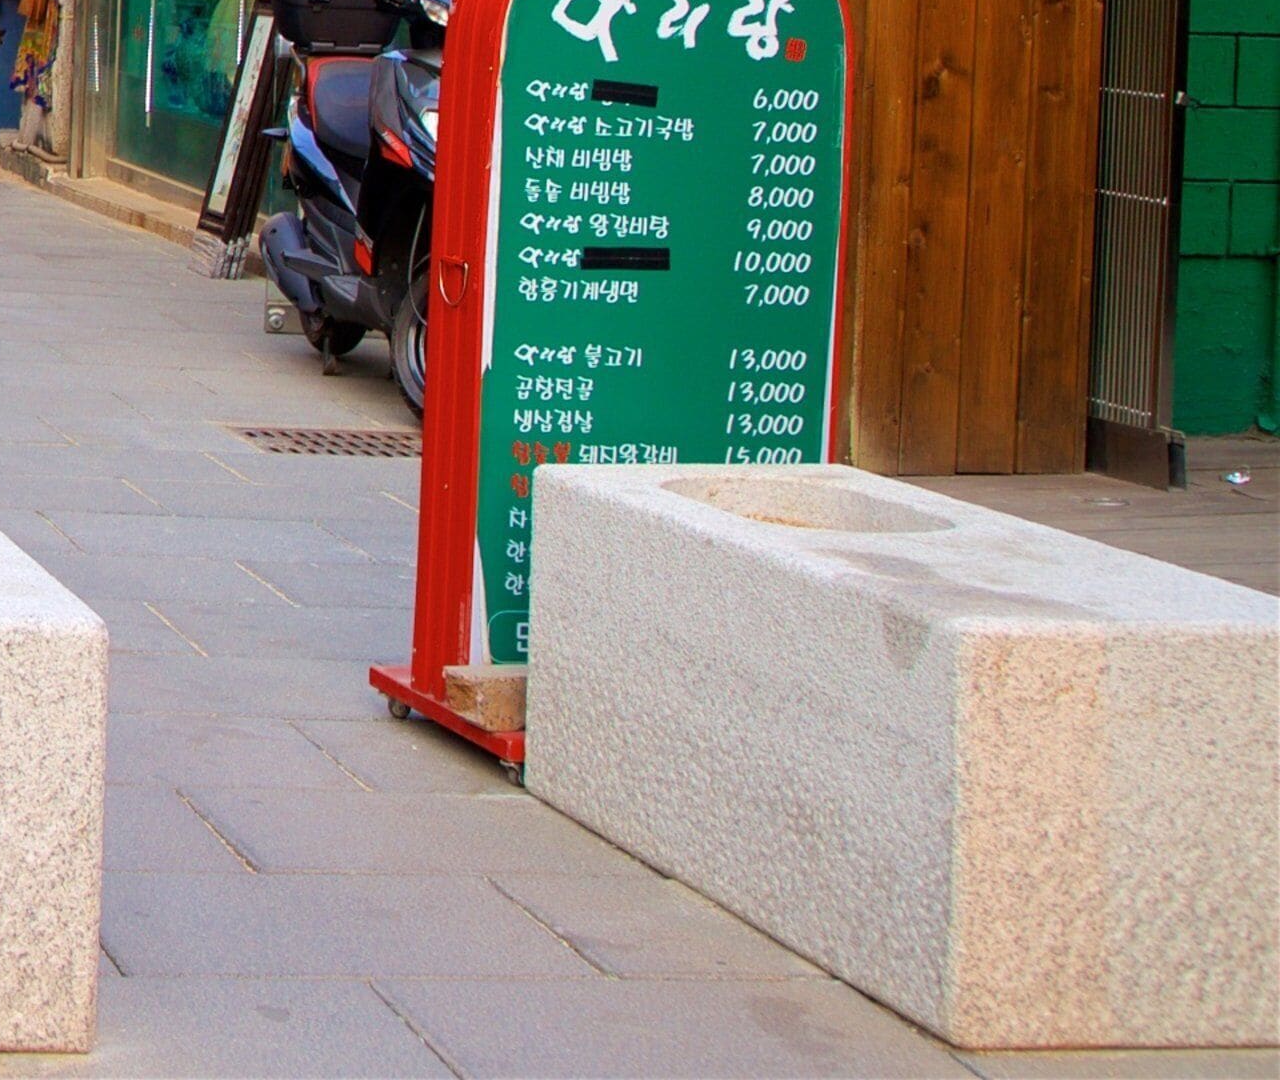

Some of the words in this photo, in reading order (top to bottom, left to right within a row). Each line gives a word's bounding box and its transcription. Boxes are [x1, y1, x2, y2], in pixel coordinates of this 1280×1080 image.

[752, 89, 819, 111] 6,000
[595, 115, 694, 141] 소고기국밥
[752, 121, 817, 143] 7,000
[751, 154, 816, 176] 7,000
[748, 187, 814, 208] 8,000
[589, 213, 670, 239] 왕갈비탕
[746, 219, 813, 242] 9,000
[733, 251, 812, 274] 10,000
[744, 284, 810, 306] 7,000
[584, 343, 642, 369] 불고기
[729, 349, 807, 372] 13,000
[728, 382, 805, 404] 13,000
[726, 415, 803, 437] 13,000
